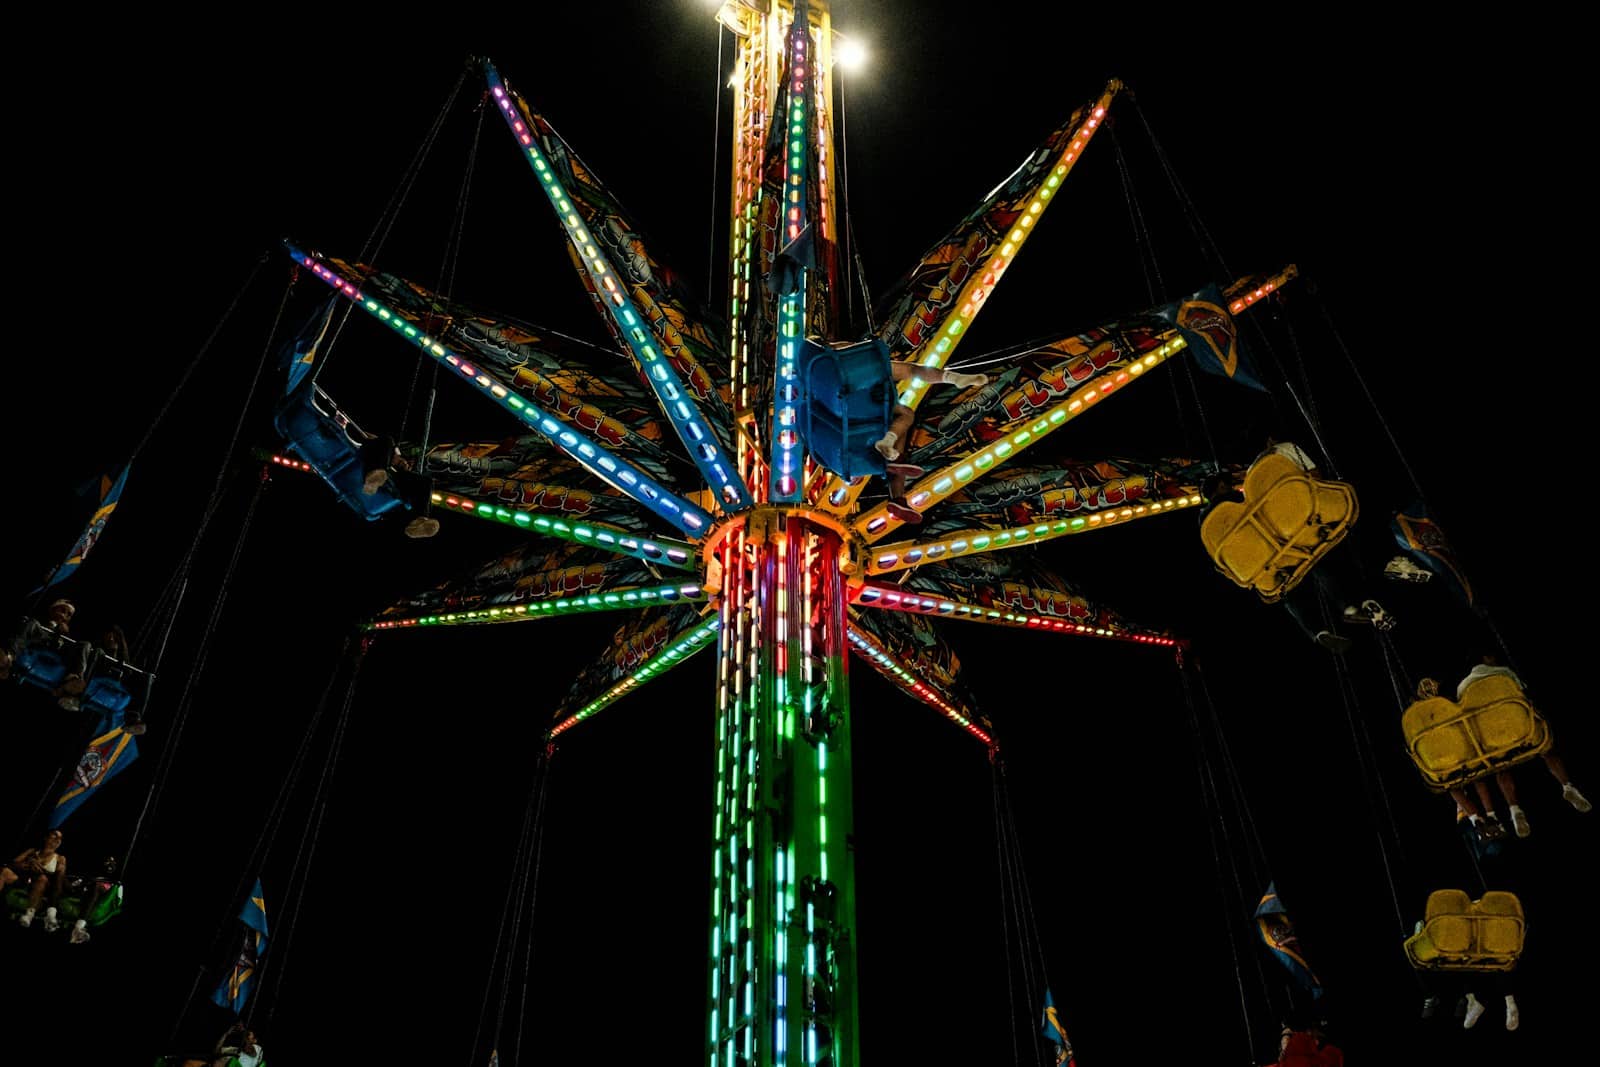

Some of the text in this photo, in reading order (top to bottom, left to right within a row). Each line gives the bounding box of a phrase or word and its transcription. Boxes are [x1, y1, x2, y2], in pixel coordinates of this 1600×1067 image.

[901, 231, 988, 348] FLYER
[512, 366, 630, 447] FLYER
[1001, 340, 1122, 421] FLYER
[479, 476, 595, 514] FLYER
[1041, 475, 1150, 516] FLYER
[1001, 581, 1092, 620] FLYER
